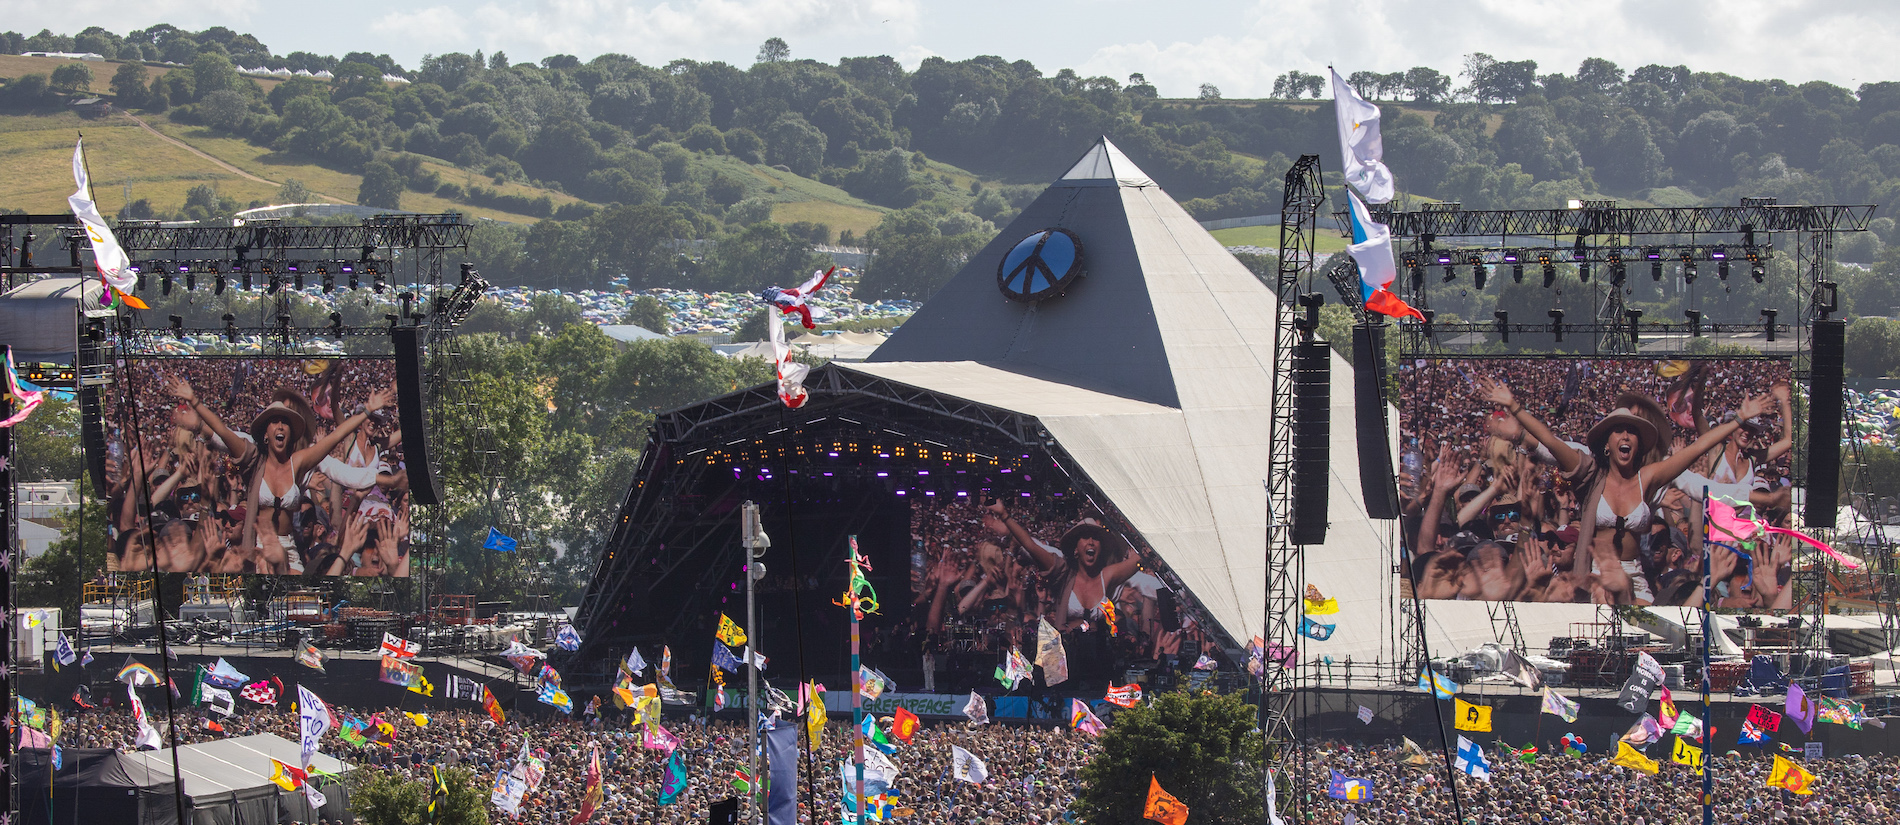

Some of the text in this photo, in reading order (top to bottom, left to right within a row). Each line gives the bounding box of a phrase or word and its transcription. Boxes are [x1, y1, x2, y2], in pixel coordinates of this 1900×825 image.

[1636, 666, 1657, 683] MONDA
[862, 697, 955, 714] GREENPEACE
[302, 715, 323, 736] TO
[1755, 712, 1774, 723] LADS
[1757, 719, 1776, 730] LADS
